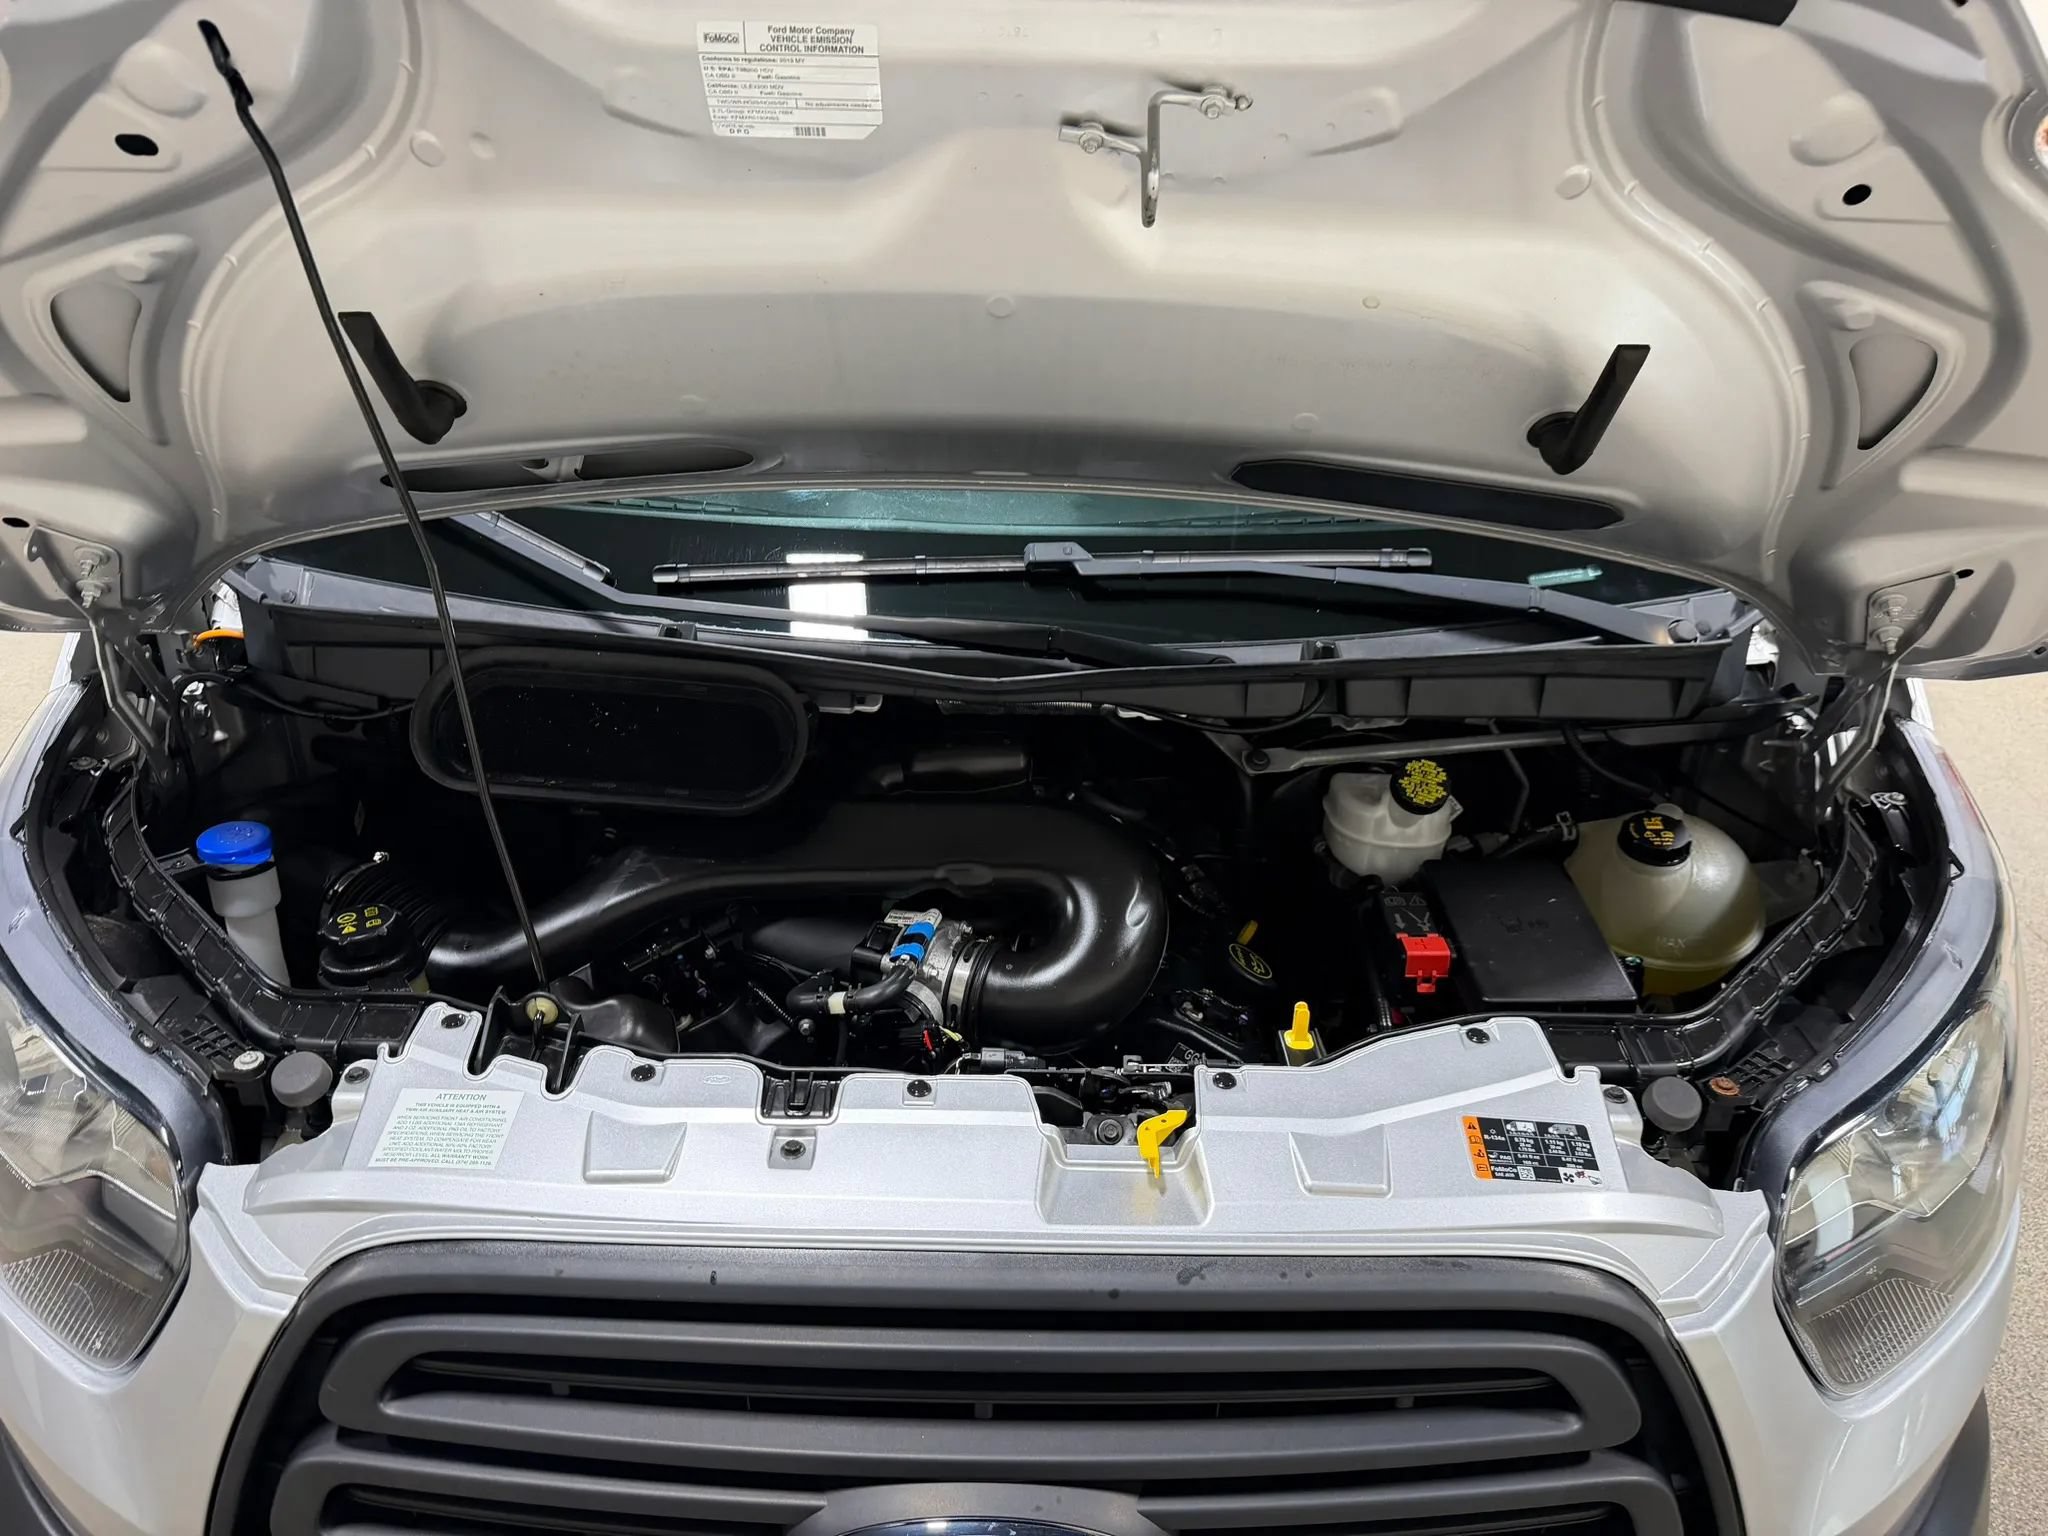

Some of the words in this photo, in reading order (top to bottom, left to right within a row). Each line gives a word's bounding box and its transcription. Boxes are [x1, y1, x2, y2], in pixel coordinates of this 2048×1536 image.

[768, 26, 787, 34] Ford
[789, 26, 813, 34] Motor
[816, 27, 855, 37] Company
[704, 32, 739, 44] FoMoCo
[770, 35, 808, 44] VEHICLE
[810, 36, 852, 44] EMISSION
[804, 45, 864, 54] INFORMATION
[436, 1093, 487, 1101] ATTENTION
